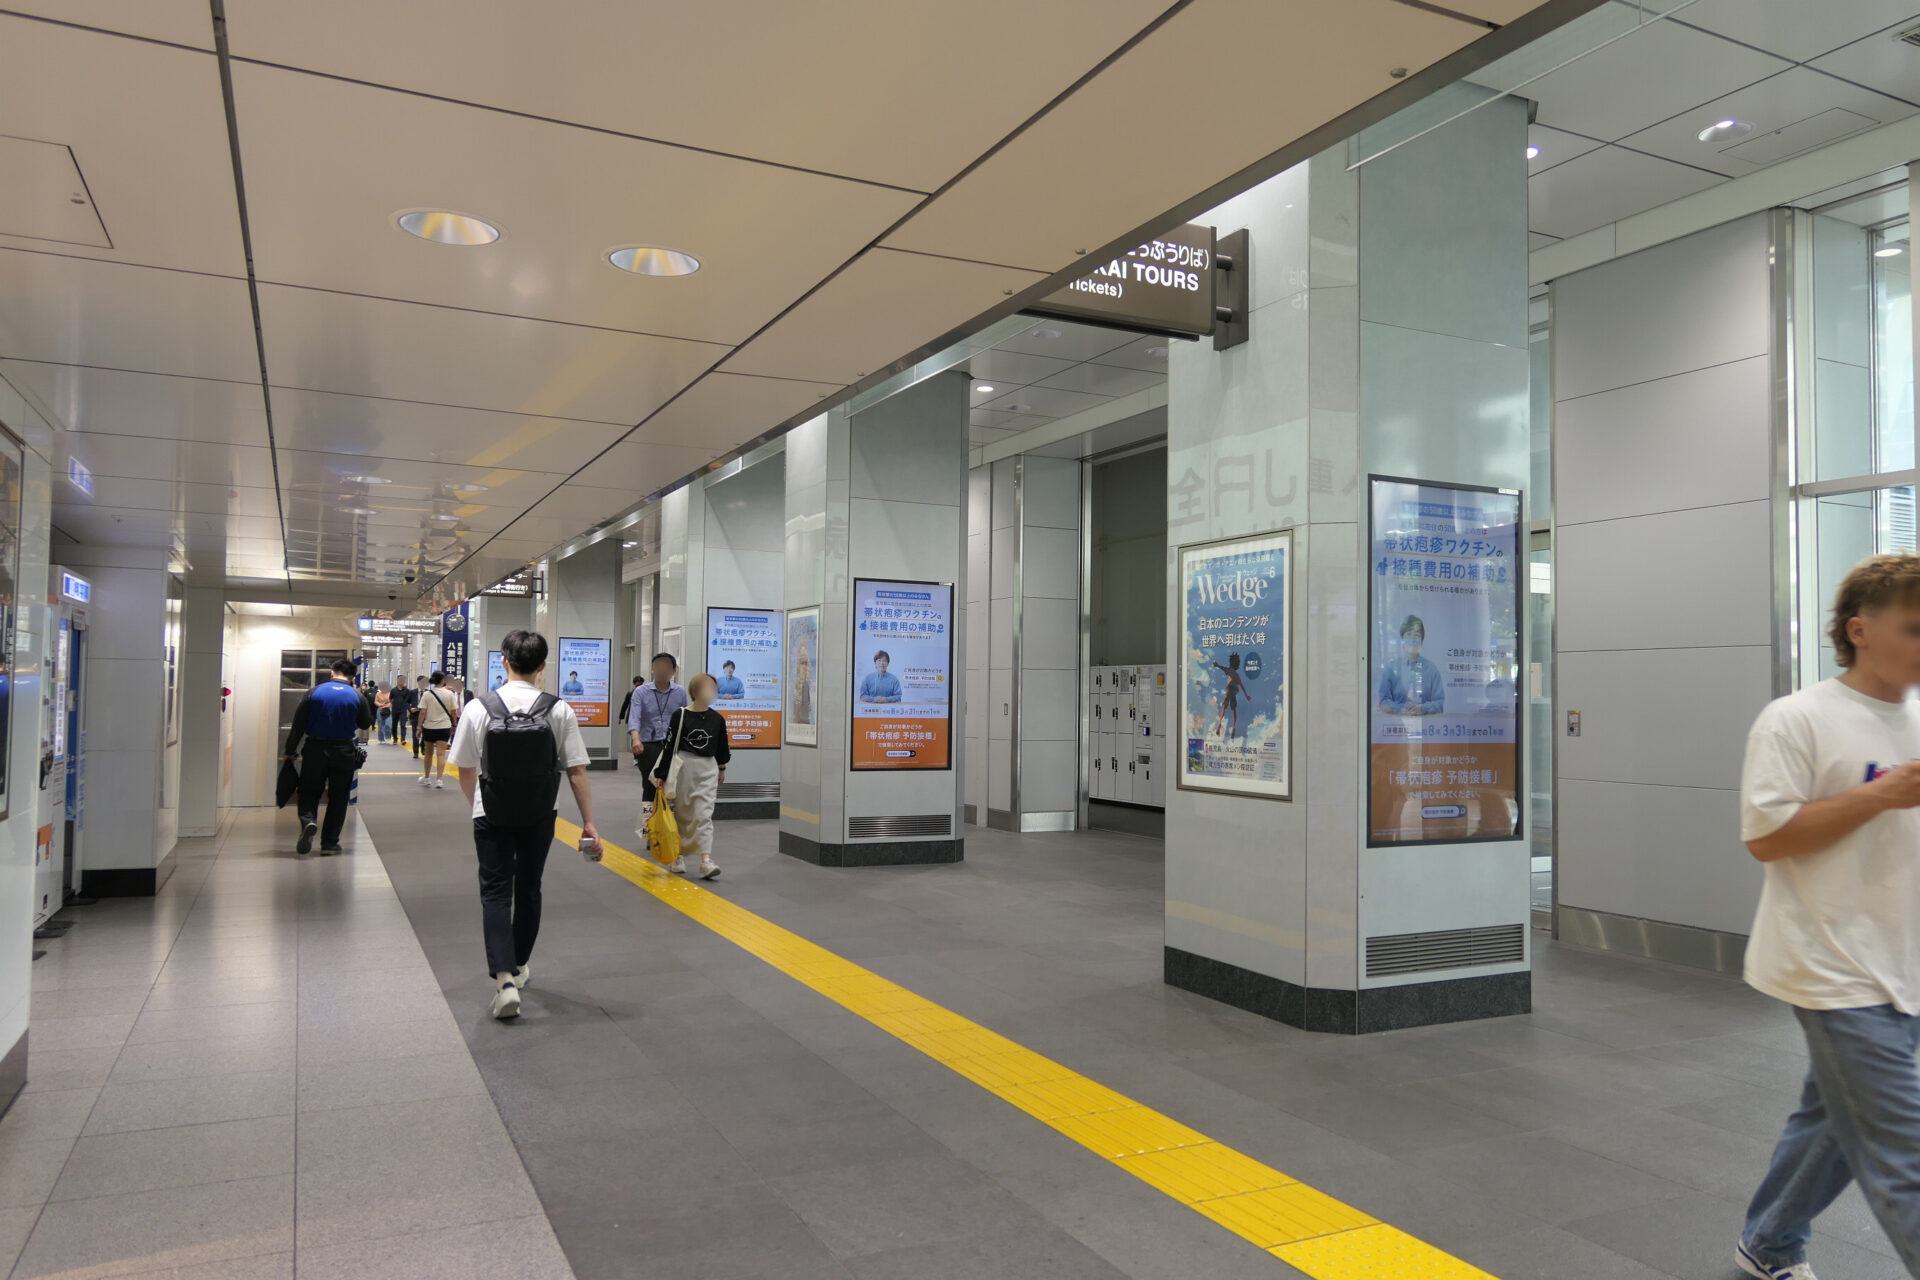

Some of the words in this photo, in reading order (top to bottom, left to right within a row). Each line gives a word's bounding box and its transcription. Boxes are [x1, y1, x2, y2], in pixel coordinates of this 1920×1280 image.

[1133, 262, 1200, 292] TOURS
[1385, 535, 1503, 558] 帯状疱疹ワクチンの
[1269, 566, 1276, 579] 6
[1393, 558, 1495, 582] 接種費用の補助
[1197, 571, 1269, 608] Wedge
[1199, 615, 1269, 631] 日本のコンテンツが
[1202, 632, 1266, 647] 世界へ羽ばたく時
